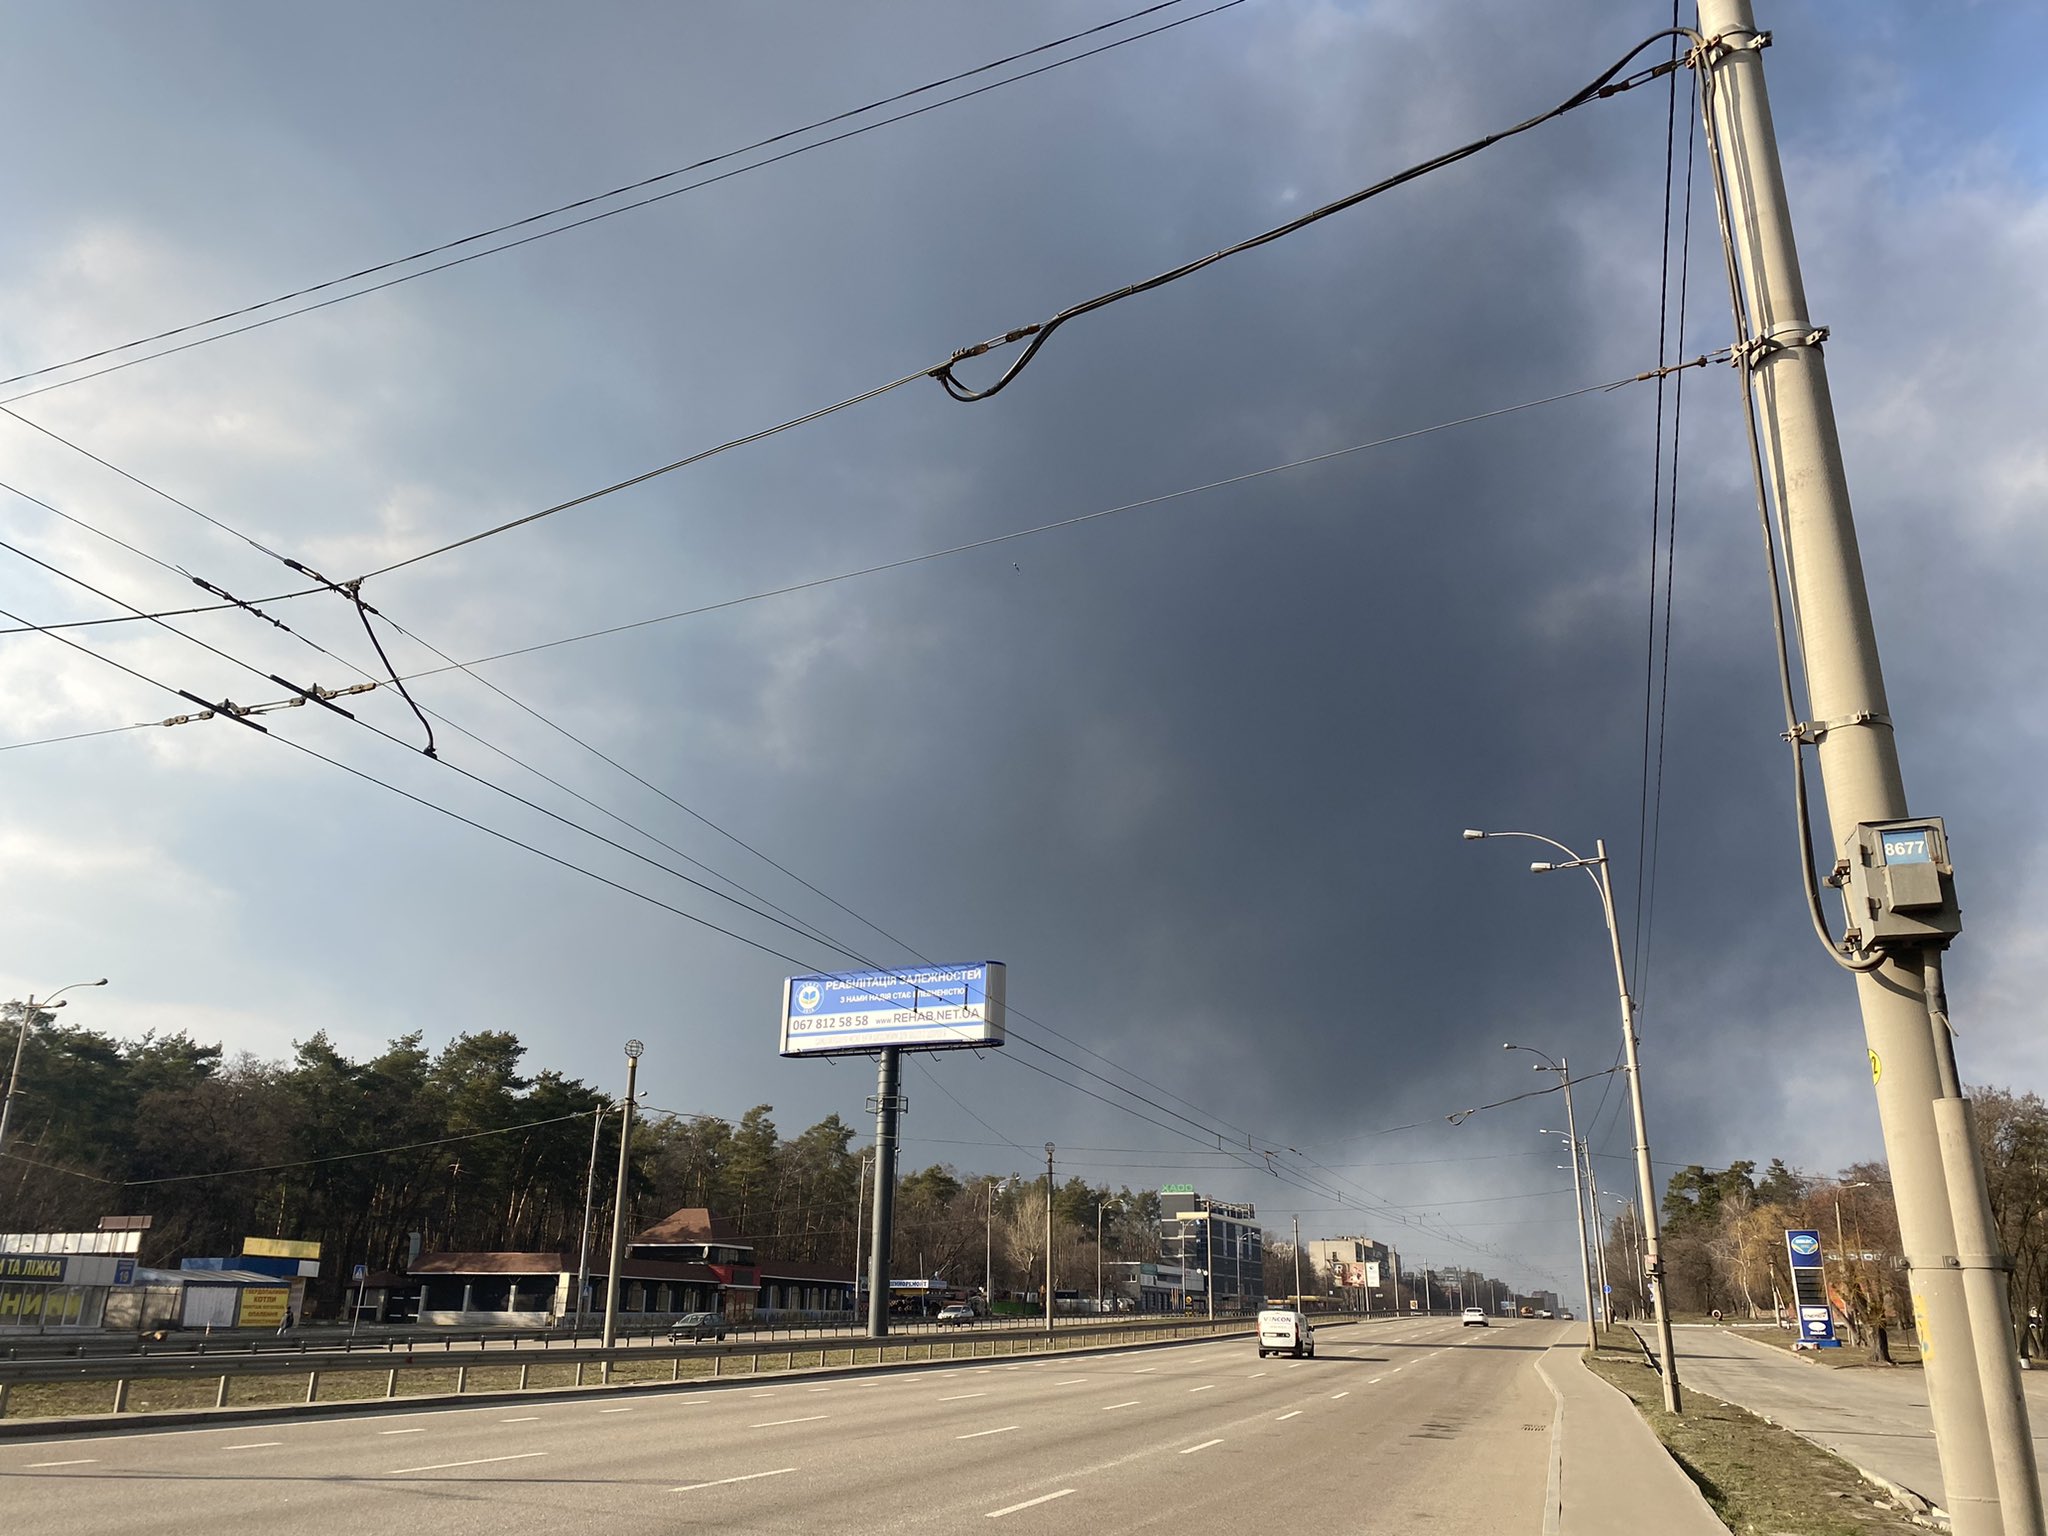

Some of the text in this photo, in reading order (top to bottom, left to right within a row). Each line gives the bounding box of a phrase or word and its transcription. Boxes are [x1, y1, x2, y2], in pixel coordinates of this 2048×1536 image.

[1885, 840, 1924, 856] 8677
[825, 976, 897, 990] РЕАБІЛІТАЦІЯ
[899, 968, 982, 985] ЗАЛЕЖНОСТЕЙ
[846, 995, 867, 1003] НАМИ
[868, 993, 891, 1002] НАДІЯ
[793, 1020, 812, 1030] 067
[816, 1018, 835, 1029] 812
[839, 1017, 852, 1027] 58
[855, 1015, 868, 1026] 58
[7, 1259, 21, 1275] ТА
[22, 1259, 61, 1276] ЛІЖКА
